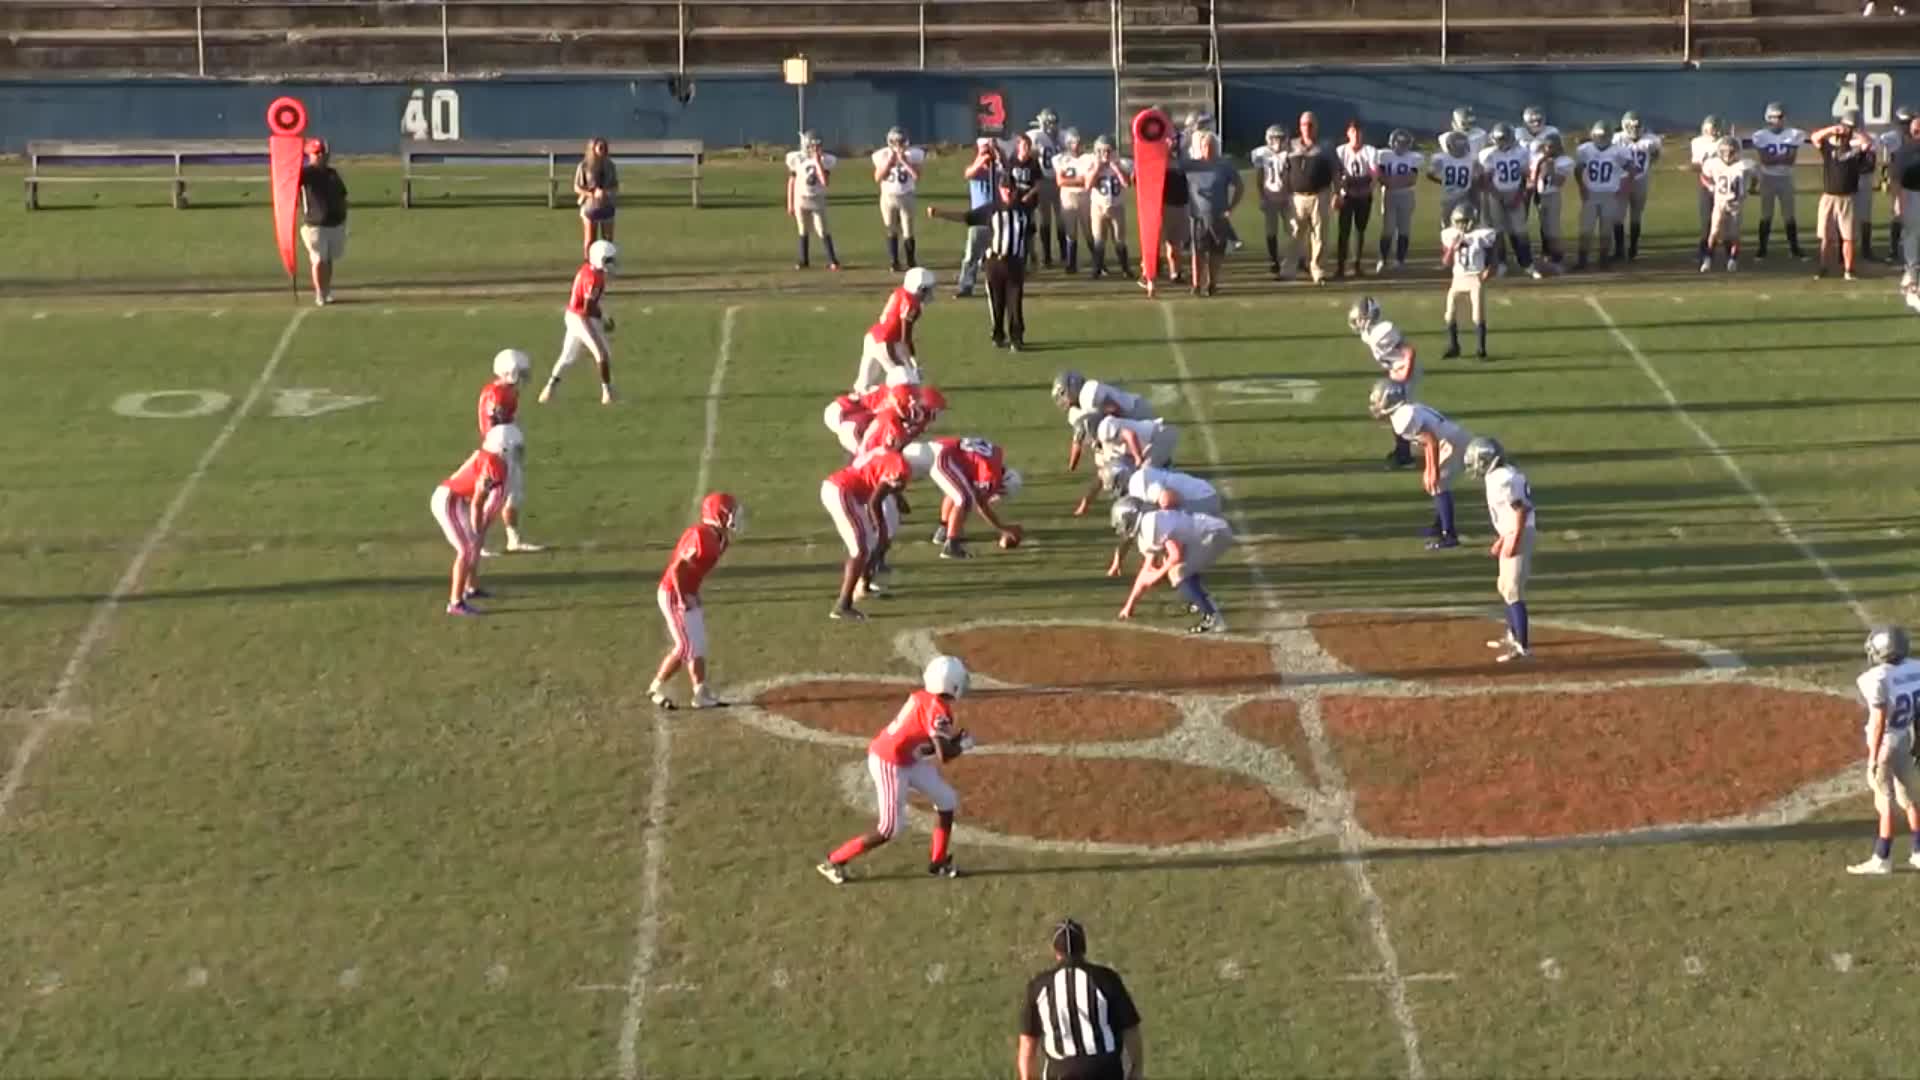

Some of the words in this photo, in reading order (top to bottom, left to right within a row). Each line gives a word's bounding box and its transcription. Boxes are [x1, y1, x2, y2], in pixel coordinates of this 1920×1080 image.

[401, 88, 459, 140] 40
[979, 94, 1006, 126] 3
[1832, 73, 1893, 125] 40
[1589, 160, 1613, 183] 60
